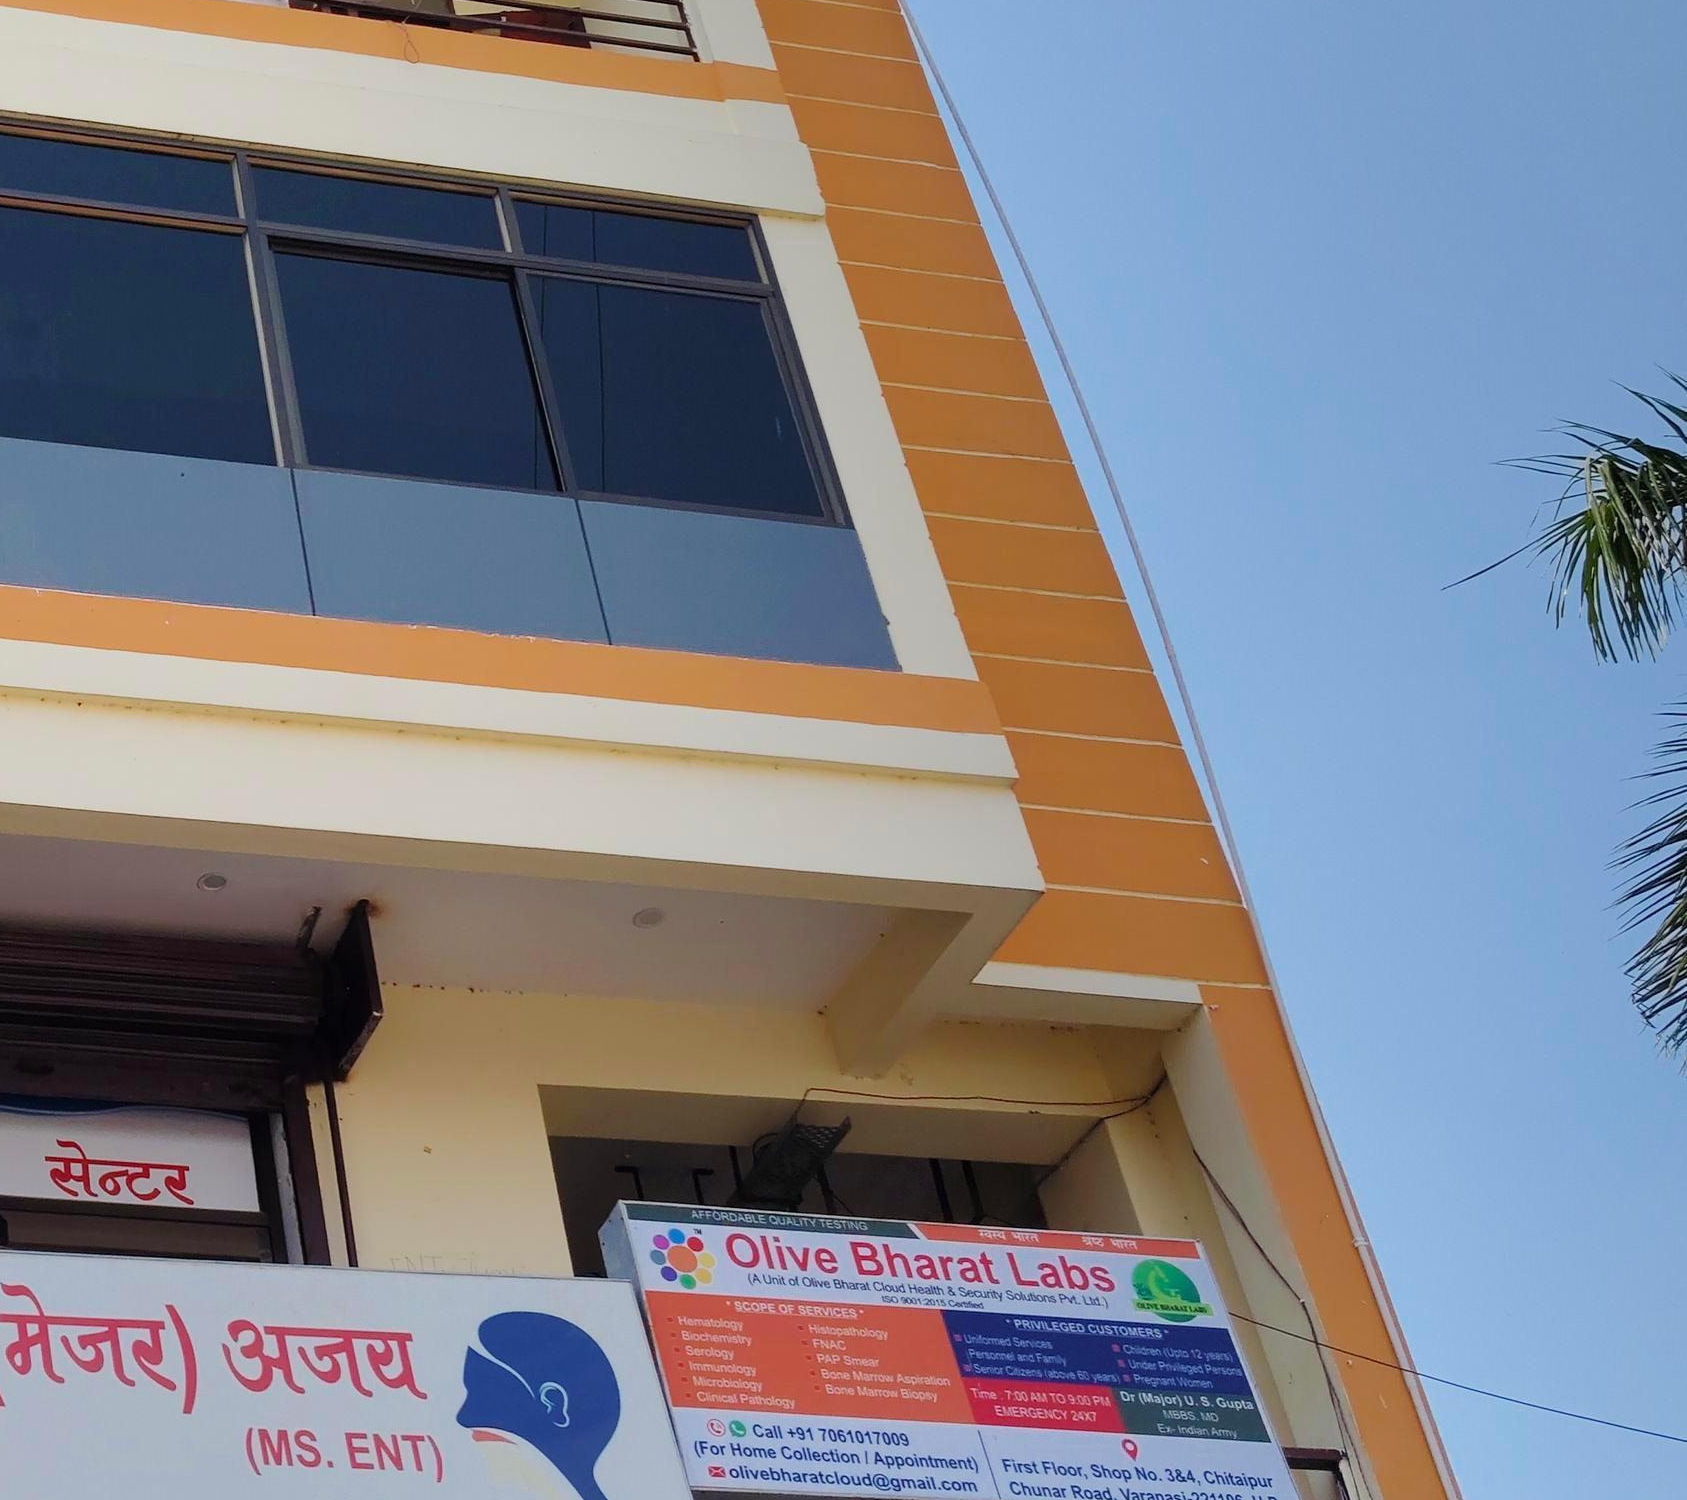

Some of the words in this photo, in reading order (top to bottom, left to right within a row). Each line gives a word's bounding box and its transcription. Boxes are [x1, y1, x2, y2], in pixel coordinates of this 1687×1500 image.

[44, 1139, 196, 1207] सेन्टर
[691, 1210, 766, 1225] AFFORDABLE
[768, 1216, 816, 1228] QUALITY
[819, 1220, 868, 1231] TESTING
[725, 1233, 840, 1274] Olive
[849, 1240, 1000, 1285] Bharat
[1006, 1252, 1116, 1292] Labs
[734, 1301, 776, 1314] SCOPE
[798, 1306, 858, 1318] SERVICES
[678, 1316, 743, 1332] Hematology
[1014, 1319, 1085, 1333] PRIVILEGED
[1088, 1324, 1162, 1338] CUSTOMERS
[681, 1331, 752, 1346] Biochemistry
[221, 1318, 429, 1401] अजय
[684, 1346, 734, 1360] Serology
[688, 1362, 756, 1376] Immunology
[692, 1376, 762, 1392] Microbiology
[696, 1391, 738, 1404] Clinical
[740, 1394, 795, 1409] Pathology
[994, 1405, 1066, 1420] EMERGENCY
[752, 1424, 782, 1440] Call
[787, 1428, 813, 1440] +91
[819, 1429, 909, 1447] 7061017009
[245, 1427, 336, 1476] (MS.
[346, 1431, 446, 1483] ENT)
[694, 1440, 726, 1459] (For
[730, 1443, 777, 1459] Home
[781, 1446, 860, 1464] Collection
[873, 1451, 979, 1474] Appointment)
[729, 1465, 979, 1492] olivebharatcloud@gmail.com
[1002, 1458, 1038, 1474] First
[1042, 1461, 1088, 1480] Floor,
[1091, 1464, 1132, 1482] Shop
[1135, 1467, 1162, 1481] No.
[1165, 1468, 1201, 1484] 3&4,
[1203, 1470, 1272, 1489] Chitaipur
[1009, 1481, 1066, 1498] Chunar
